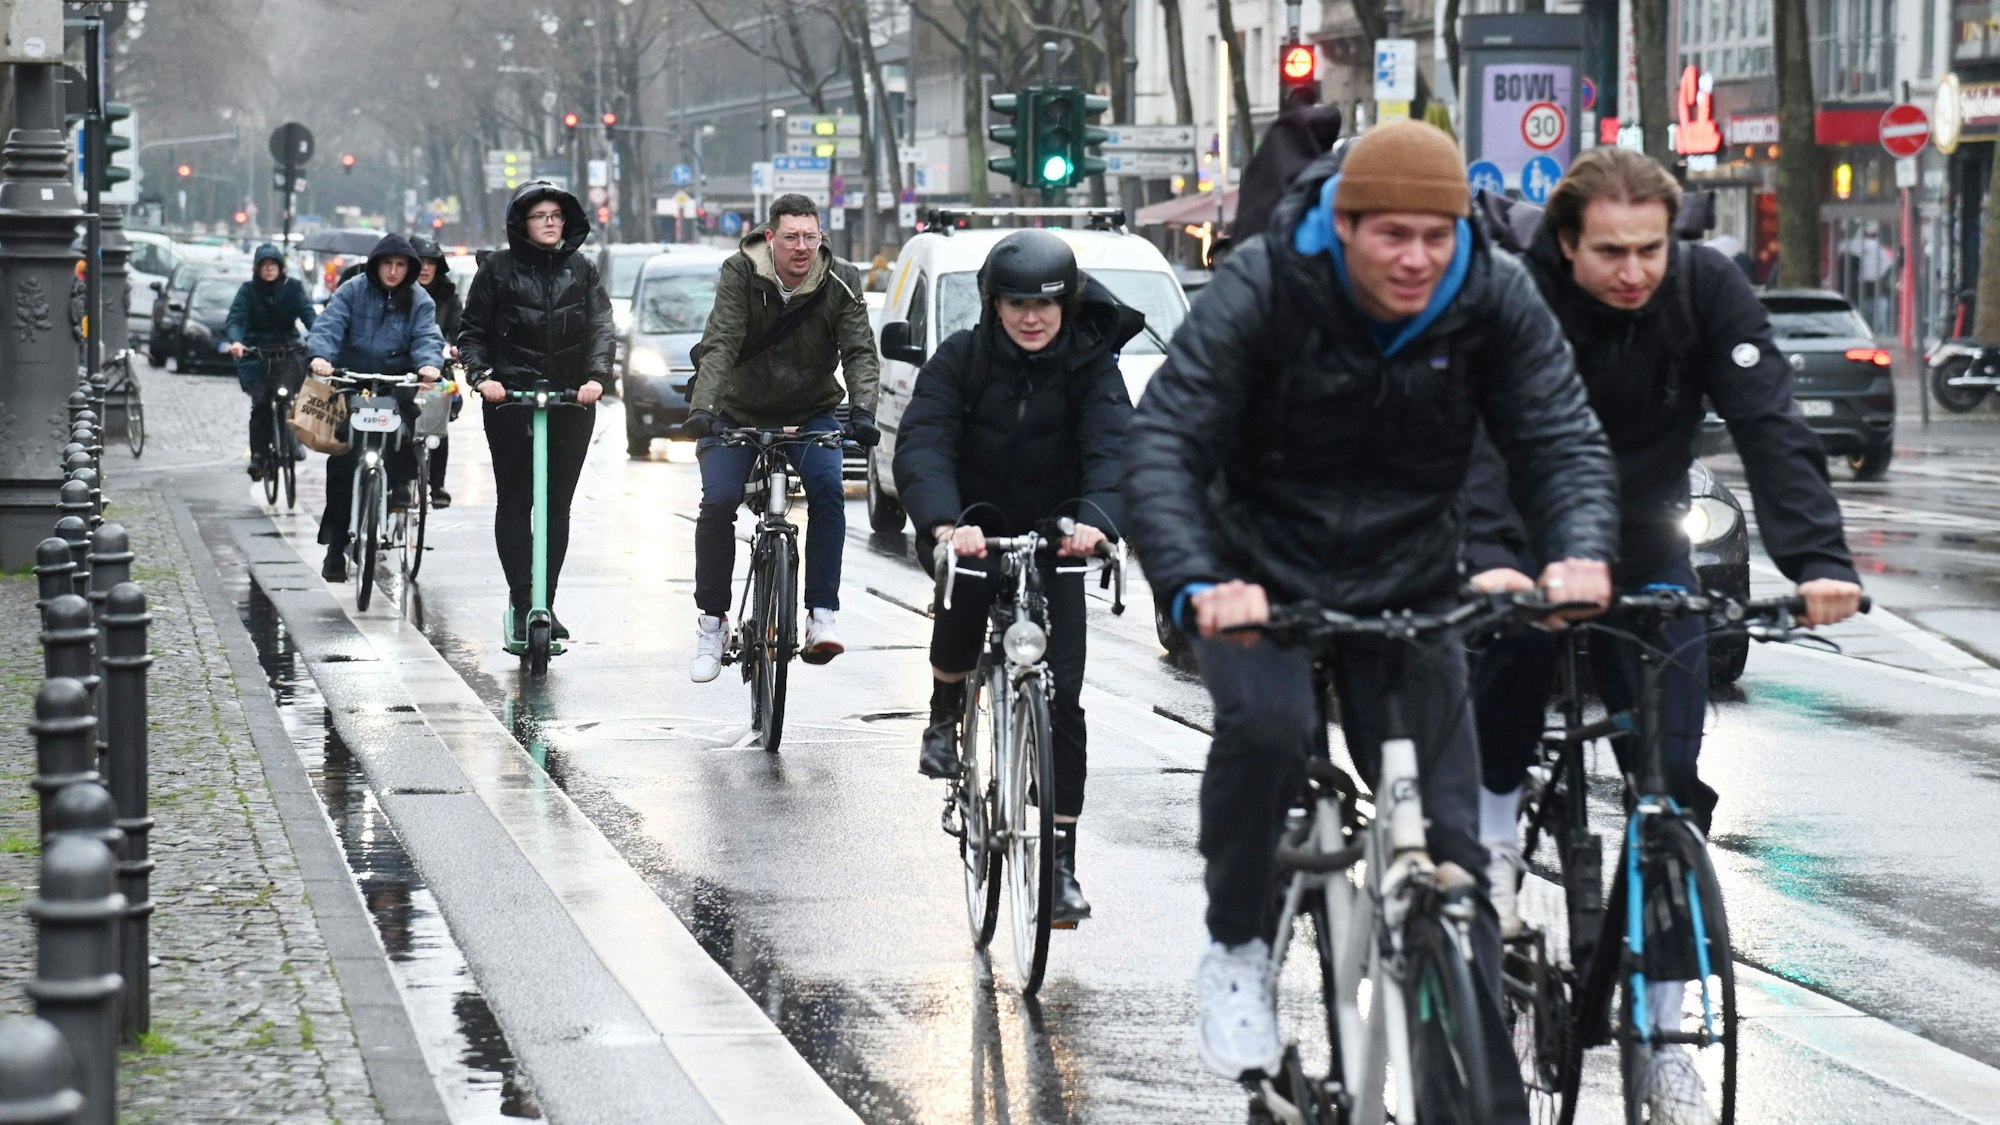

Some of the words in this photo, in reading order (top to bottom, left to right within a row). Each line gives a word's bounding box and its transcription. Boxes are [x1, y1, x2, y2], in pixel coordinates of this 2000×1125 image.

[1493, 73, 1557, 102] BOWL
[1530, 115, 1555, 137] 30
[301, 404, 326, 421] SUPER
